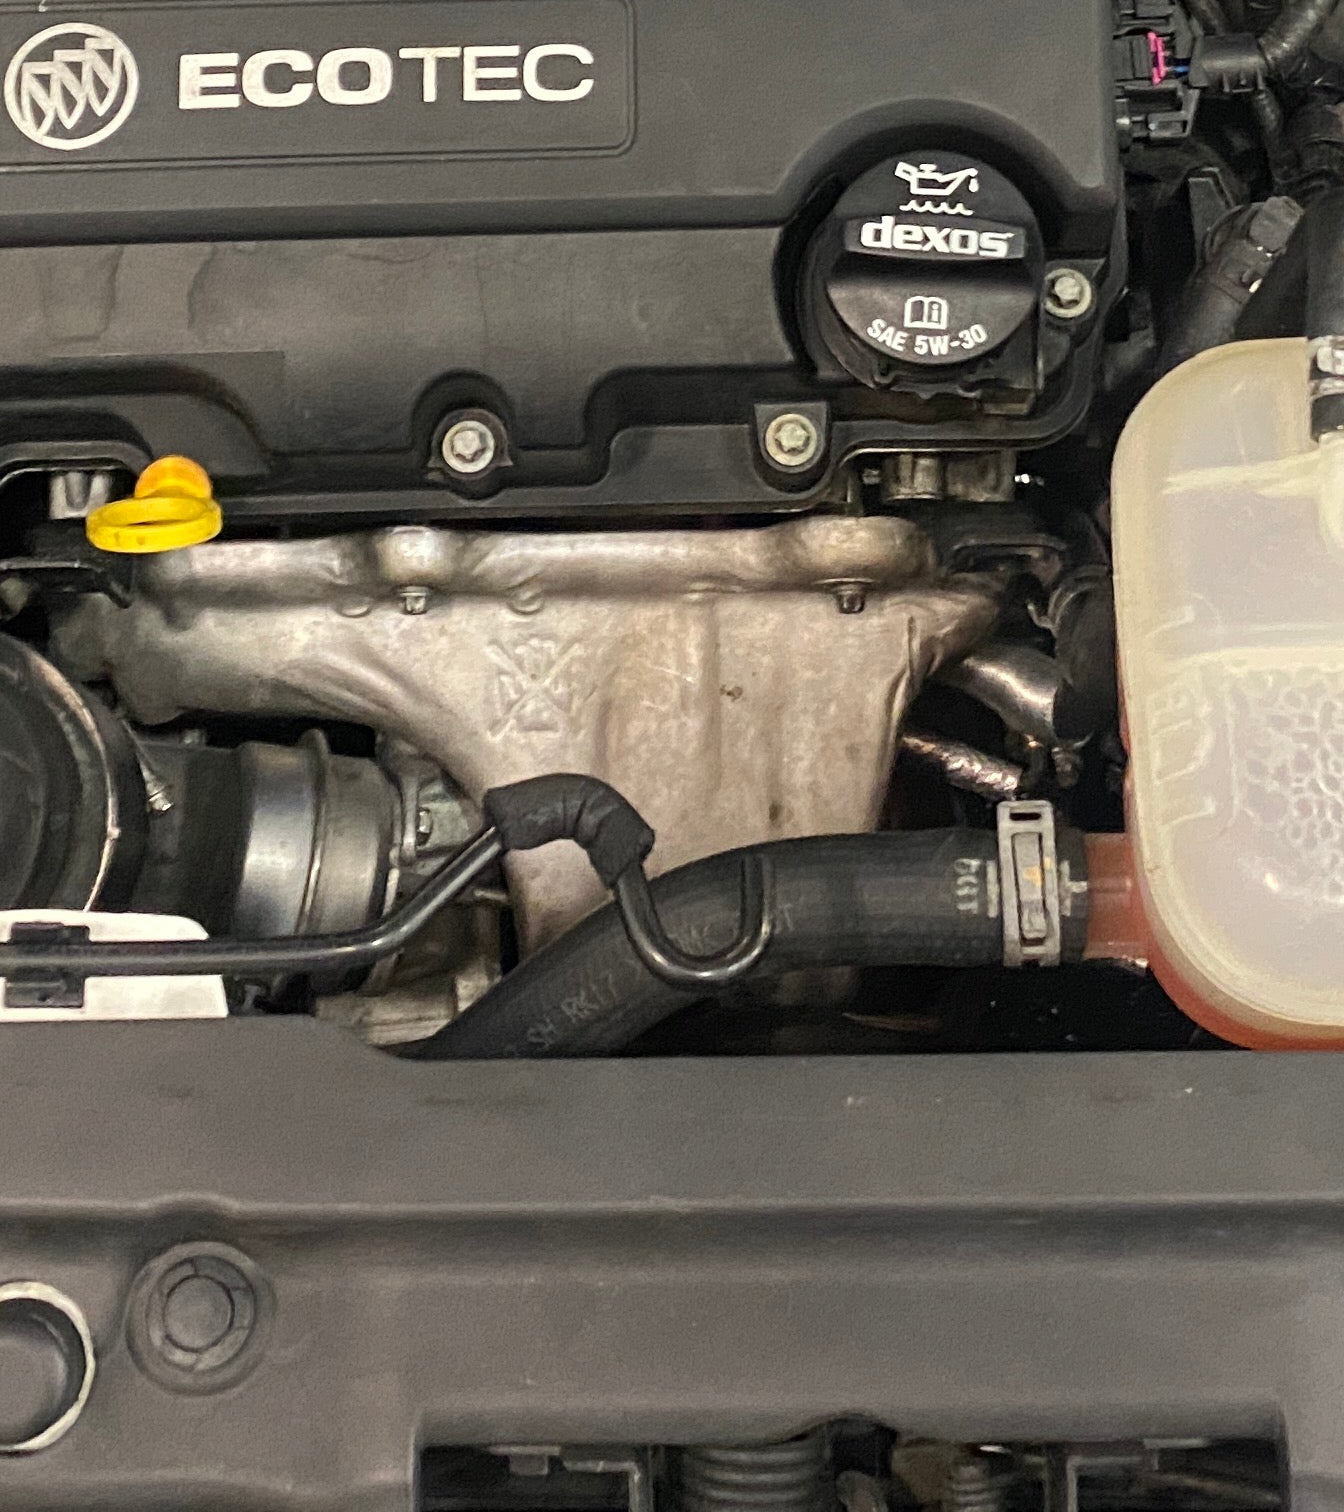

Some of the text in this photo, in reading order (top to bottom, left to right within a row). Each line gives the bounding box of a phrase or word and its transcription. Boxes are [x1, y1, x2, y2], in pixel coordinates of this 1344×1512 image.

[178, 43, 595, 110] ECOTEC
[860, 216, 1014, 258] dexos
[867, 318, 988, 356] SAE 5W-30
